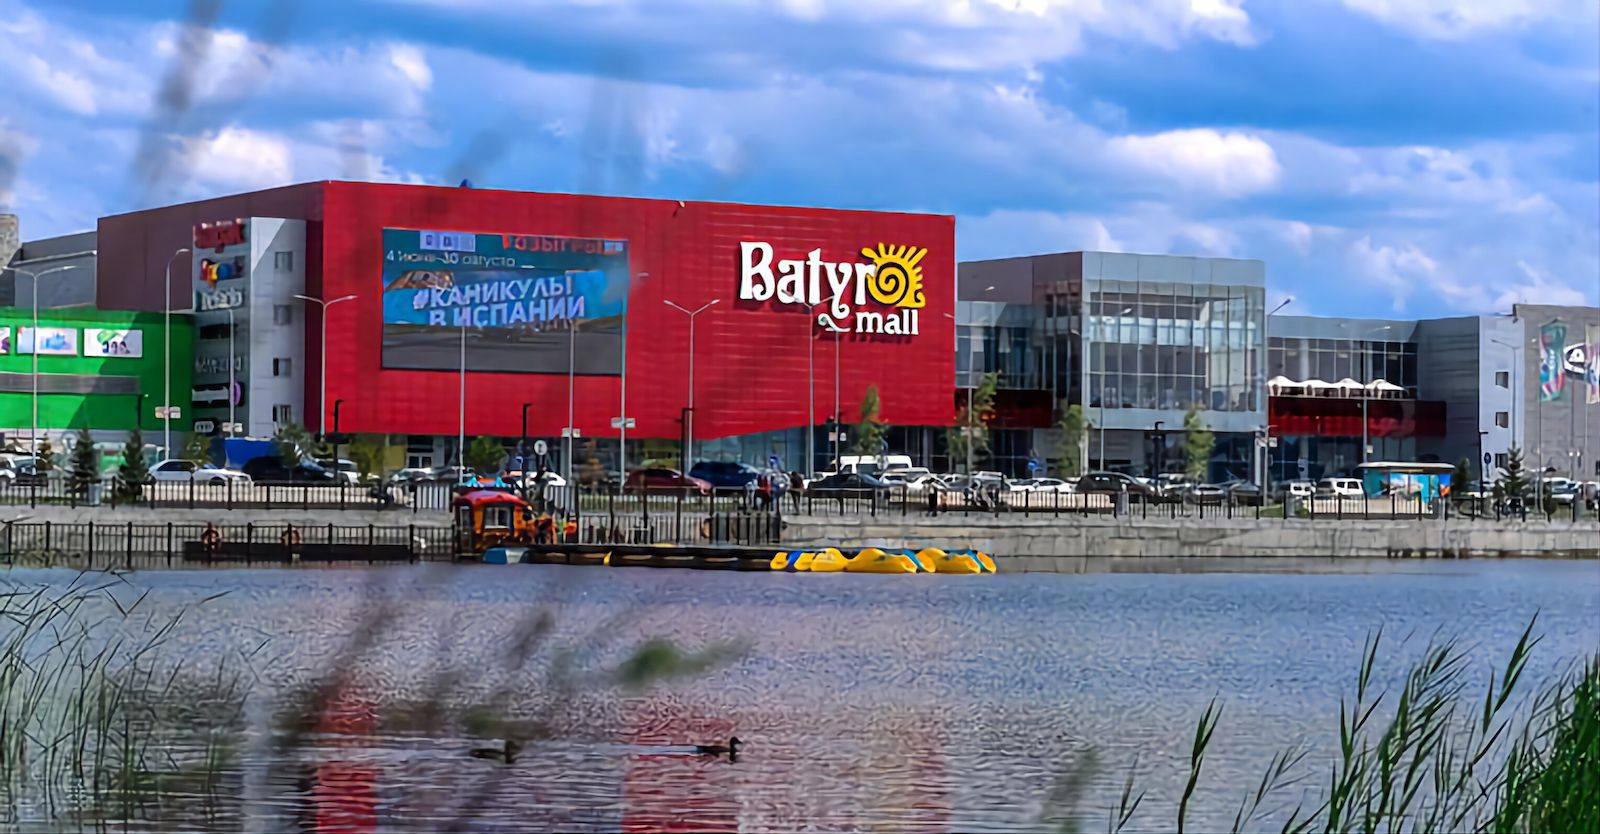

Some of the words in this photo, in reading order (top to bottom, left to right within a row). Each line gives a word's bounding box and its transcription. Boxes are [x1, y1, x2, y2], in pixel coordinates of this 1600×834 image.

[386, 249, 394, 261] 4
[740, 241, 876, 319] Batyr
[453, 295, 585, 328] ИСПАНИИ
[855, 309, 919, 335] mall
